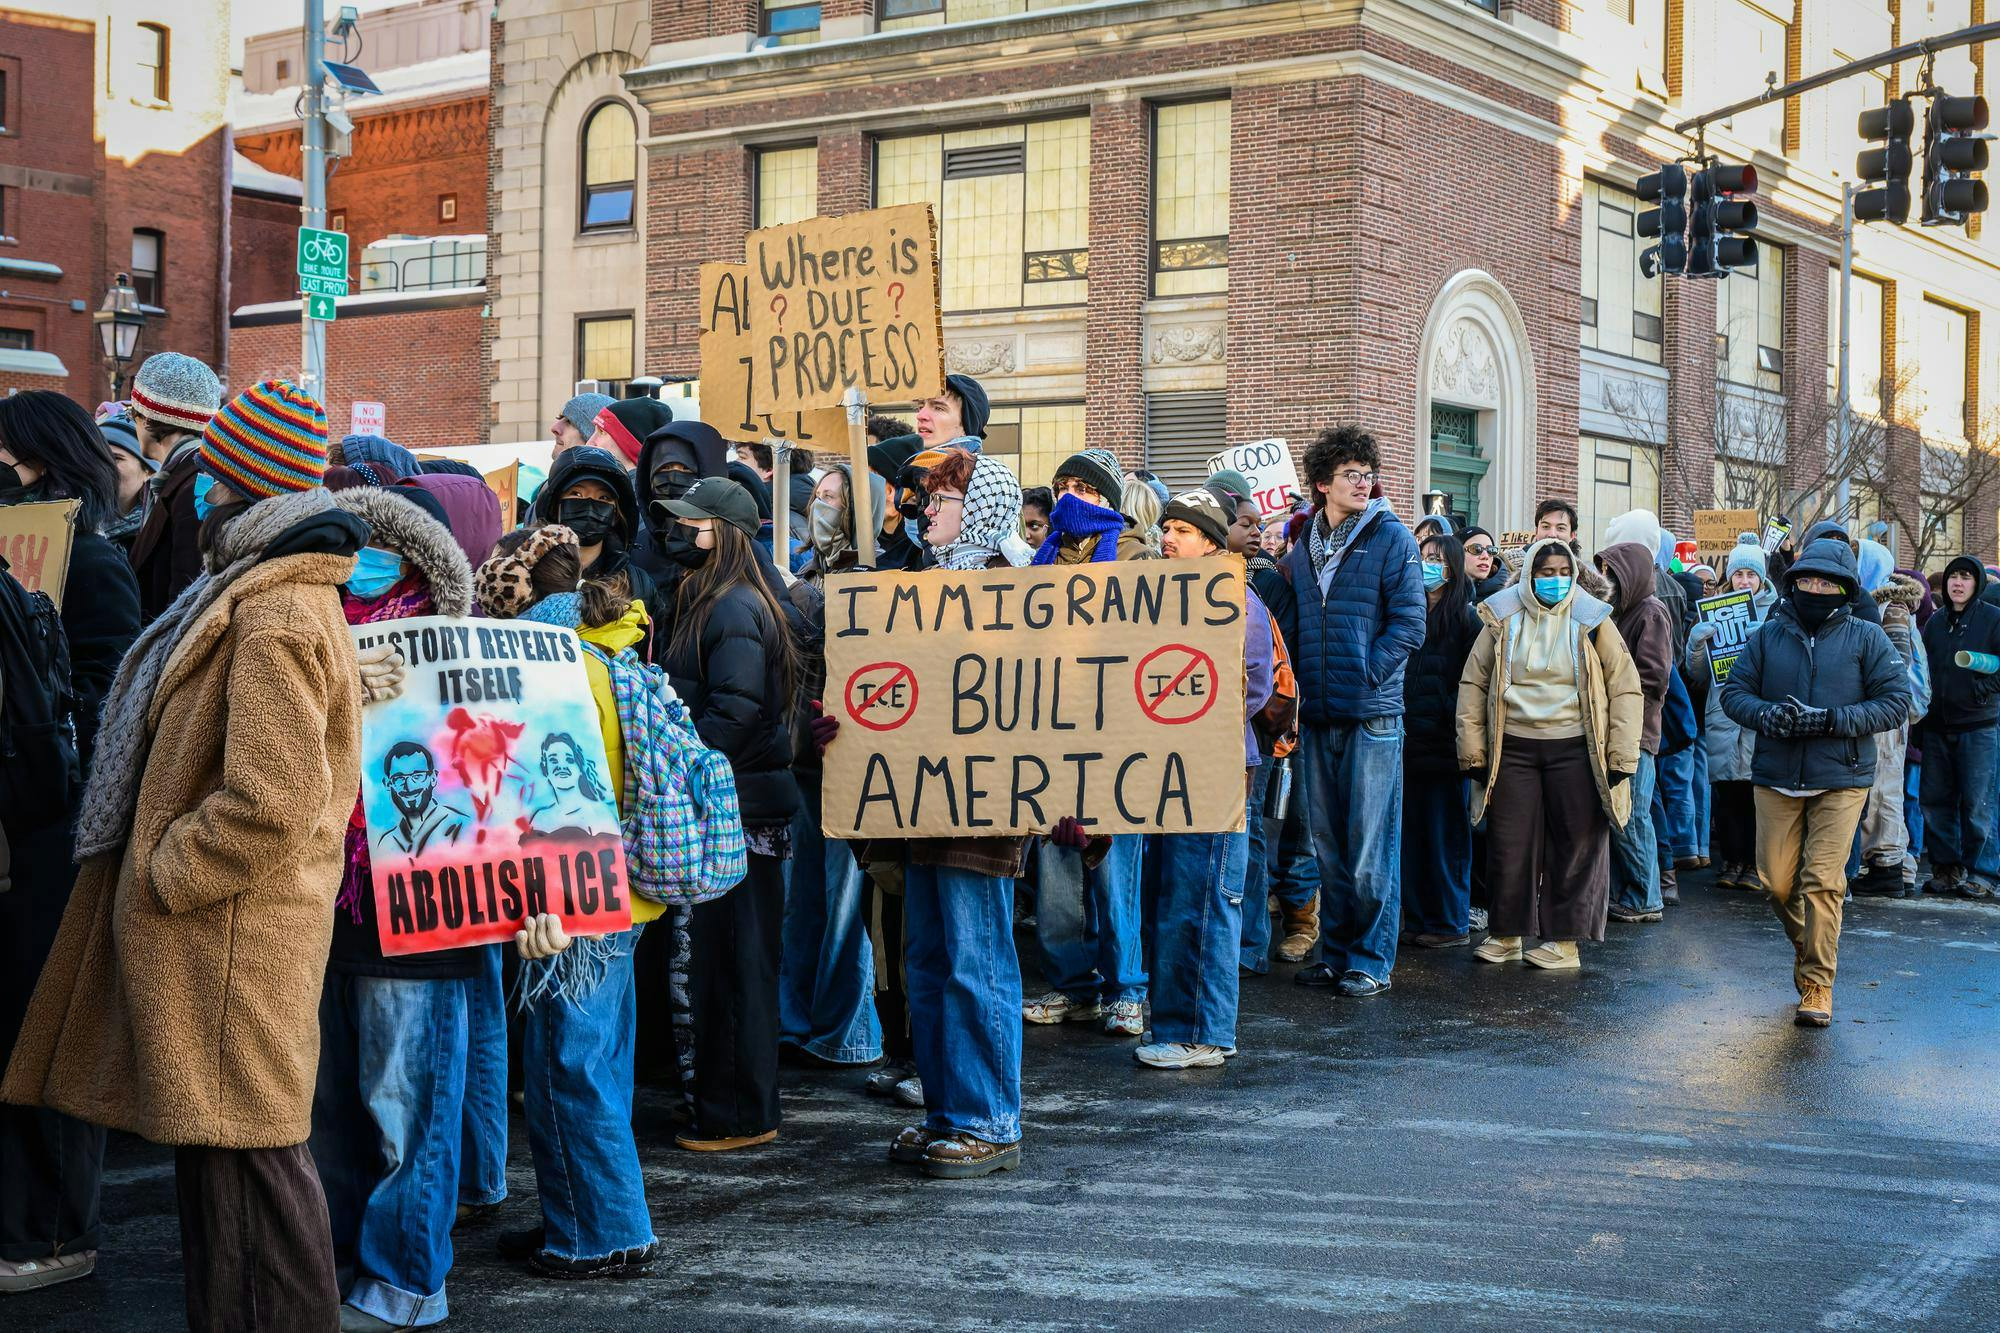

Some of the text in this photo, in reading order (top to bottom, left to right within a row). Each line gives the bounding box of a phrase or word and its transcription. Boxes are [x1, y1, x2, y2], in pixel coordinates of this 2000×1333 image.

[303, 263, 342, 278] BIKE ROUTE
[759, 228, 918, 290] Where is
[302, 277, 345, 295] EAST PROV
[807, 286, 874, 330] DUE
[769, 322, 921, 400] PROCESS
[362, 407, 375, 416] NO
[1233, 443, 1281, 472] GOOD
[1252, 484, 1293, 516] ICE
[1699, 514, 1727, 526] REMOVE
[1501, 533, 1509, 542] I
[1510, 532, 1529, 543] like
[1700, 540, 1718, 551] FROM
[836, 572, 1240, 638] IMMIGRANTS
[1707, 602, 1750, 623] ICE
[476, 627, 577, 663] REPEATS
[438, 666, 521, 705] ITSELF
[952, 653, 1129, 735] BUILT
[853, 752, 1194, 831] AMERICA
[388, 849, 621, 935] ABOLISH ICE
